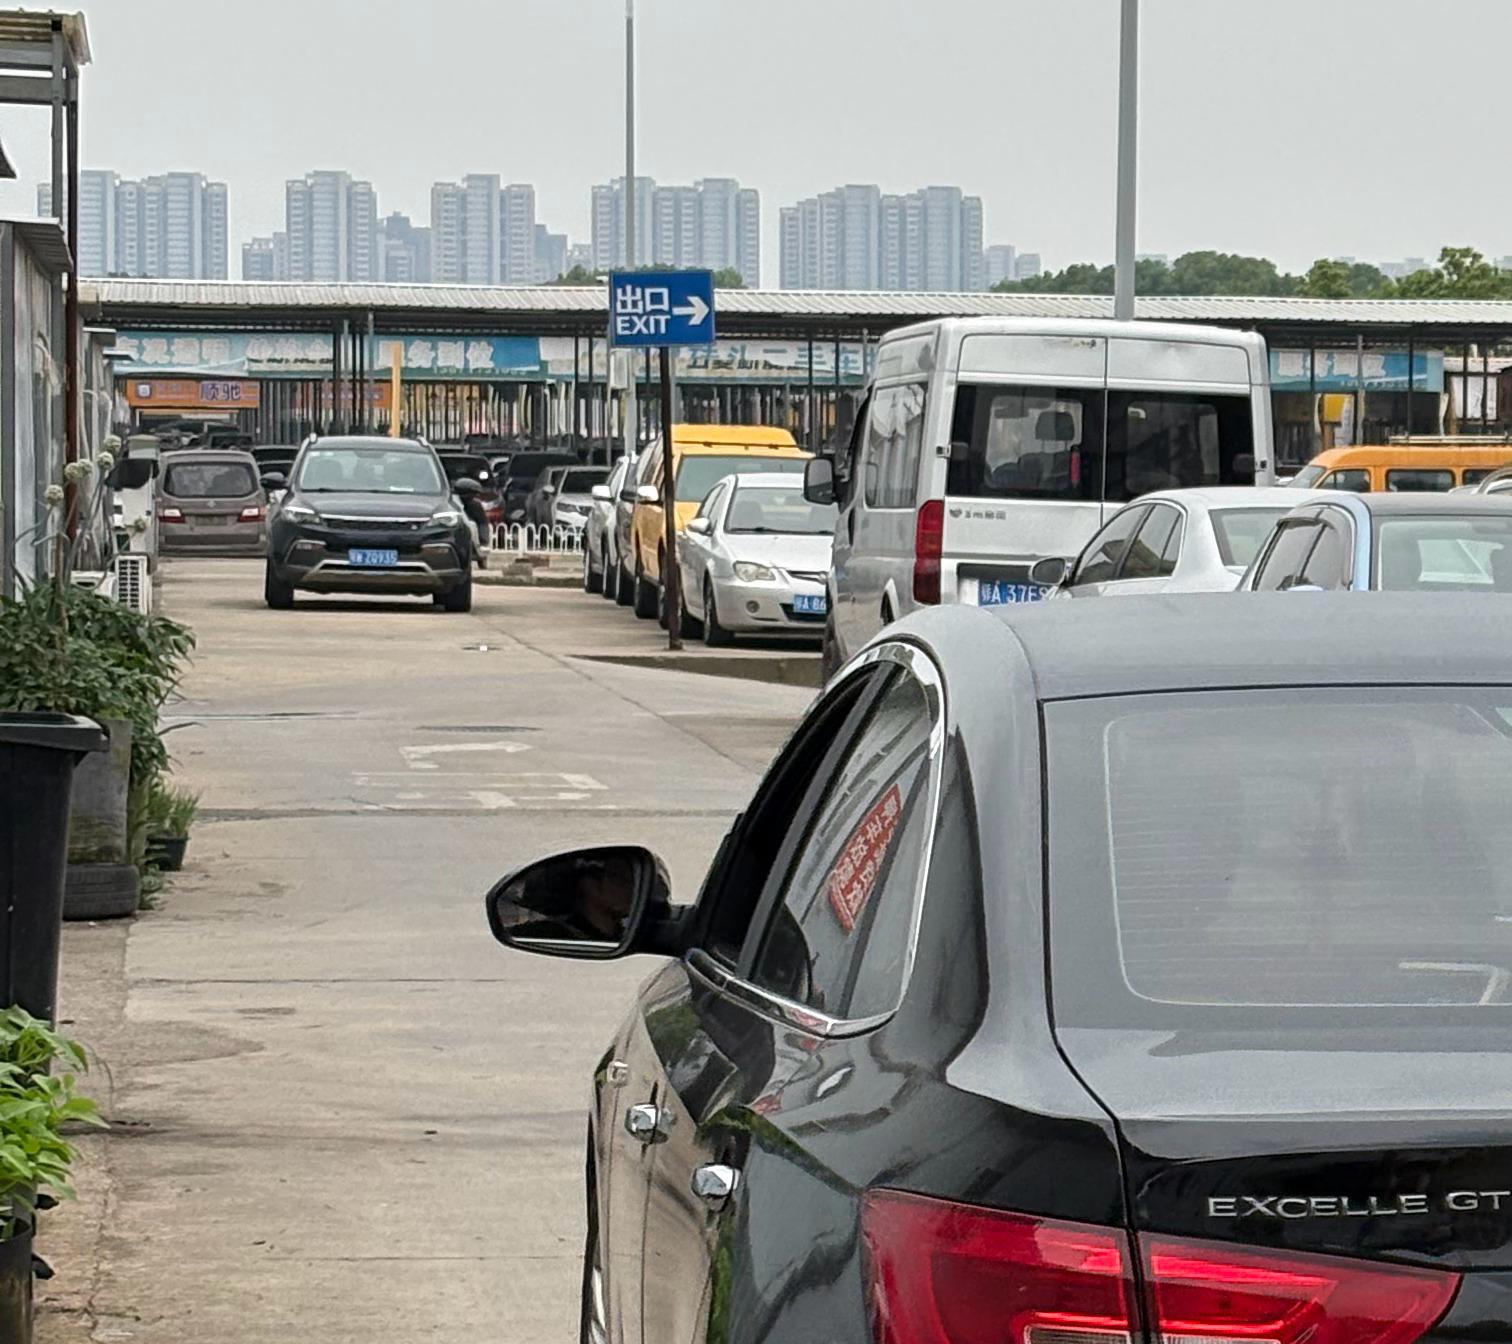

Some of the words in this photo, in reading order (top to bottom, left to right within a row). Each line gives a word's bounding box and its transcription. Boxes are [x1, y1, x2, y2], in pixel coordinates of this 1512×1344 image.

[616, 284, 670, 314] 出口
[616, 315, 671, 335] EXIT
[1207, 1193, 1430, 1219] EXCELLE
[1445, 1190, 1512, 1211] GT
